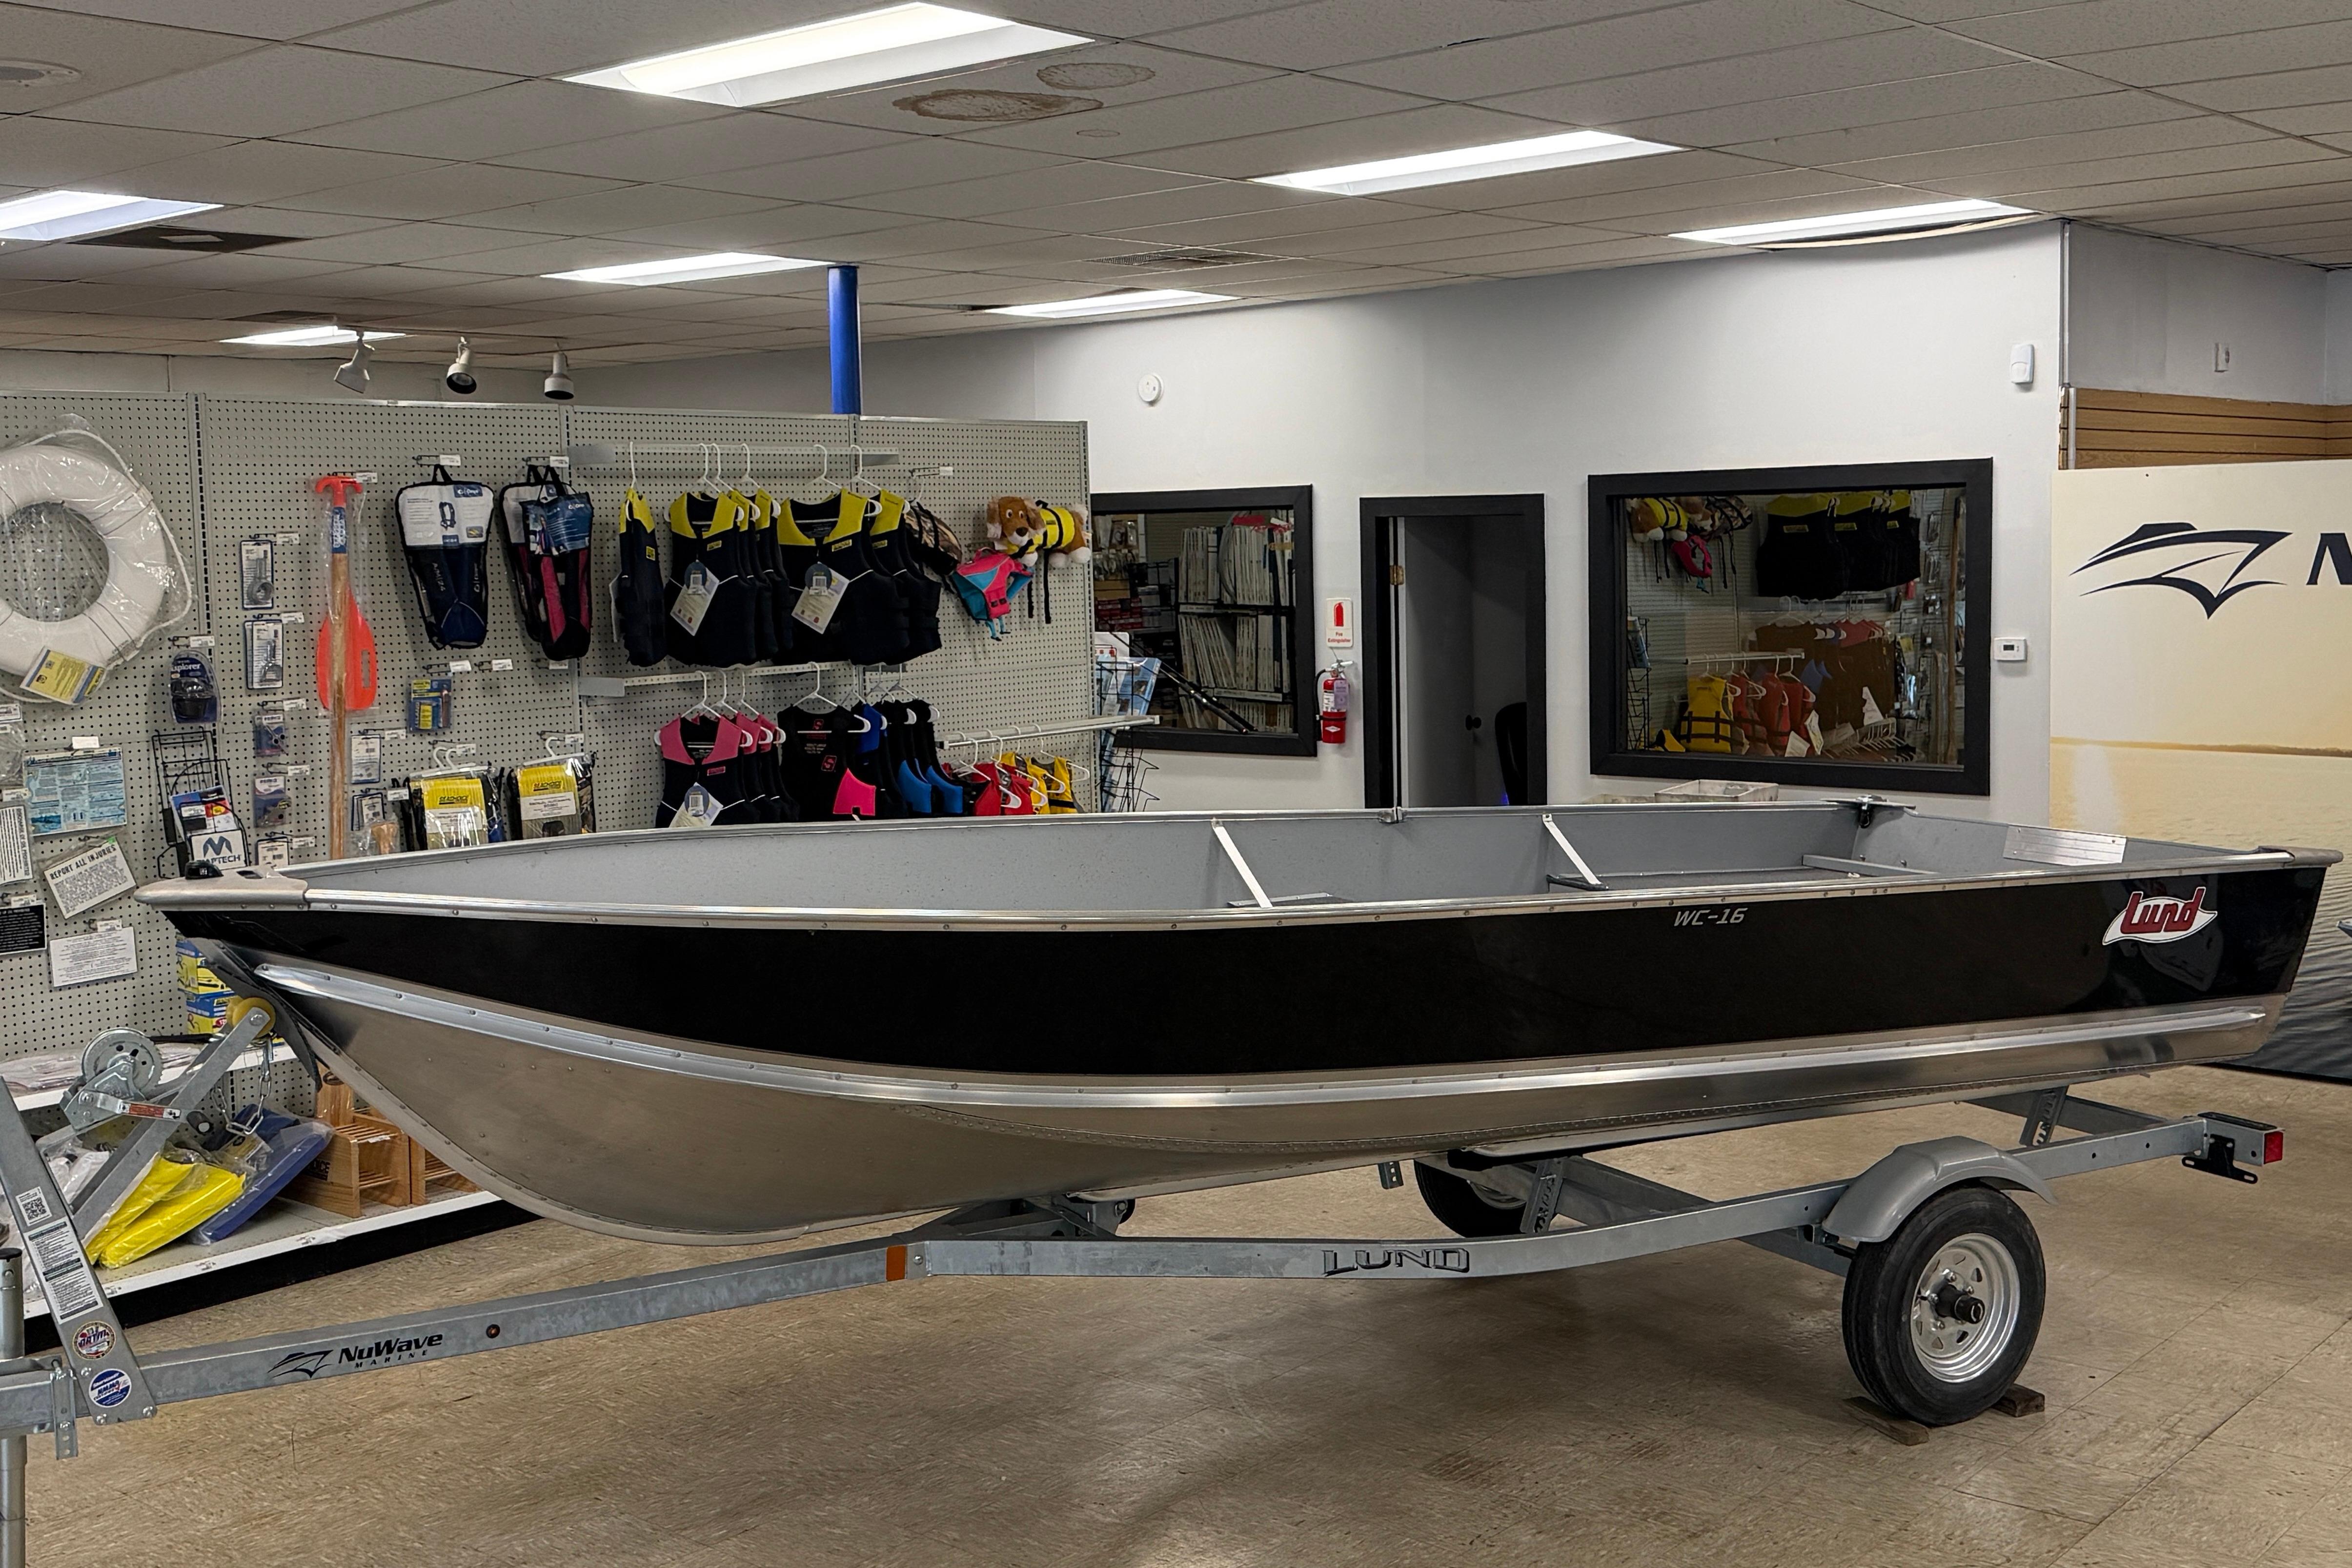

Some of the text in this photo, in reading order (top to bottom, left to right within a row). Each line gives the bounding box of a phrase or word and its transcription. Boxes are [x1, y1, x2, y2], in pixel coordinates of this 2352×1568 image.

[49, 844, 117, 880] REPORT ALL INJURIES
[1674, 908, 1748, 927] WC-16
[2120, 887, 2205, 935] Lund
[1321, 1247, 1470, 1277] LUND
[339, 1334, 443, 1364] NuWave
[354, 1349, 428, 1369] MARINE
